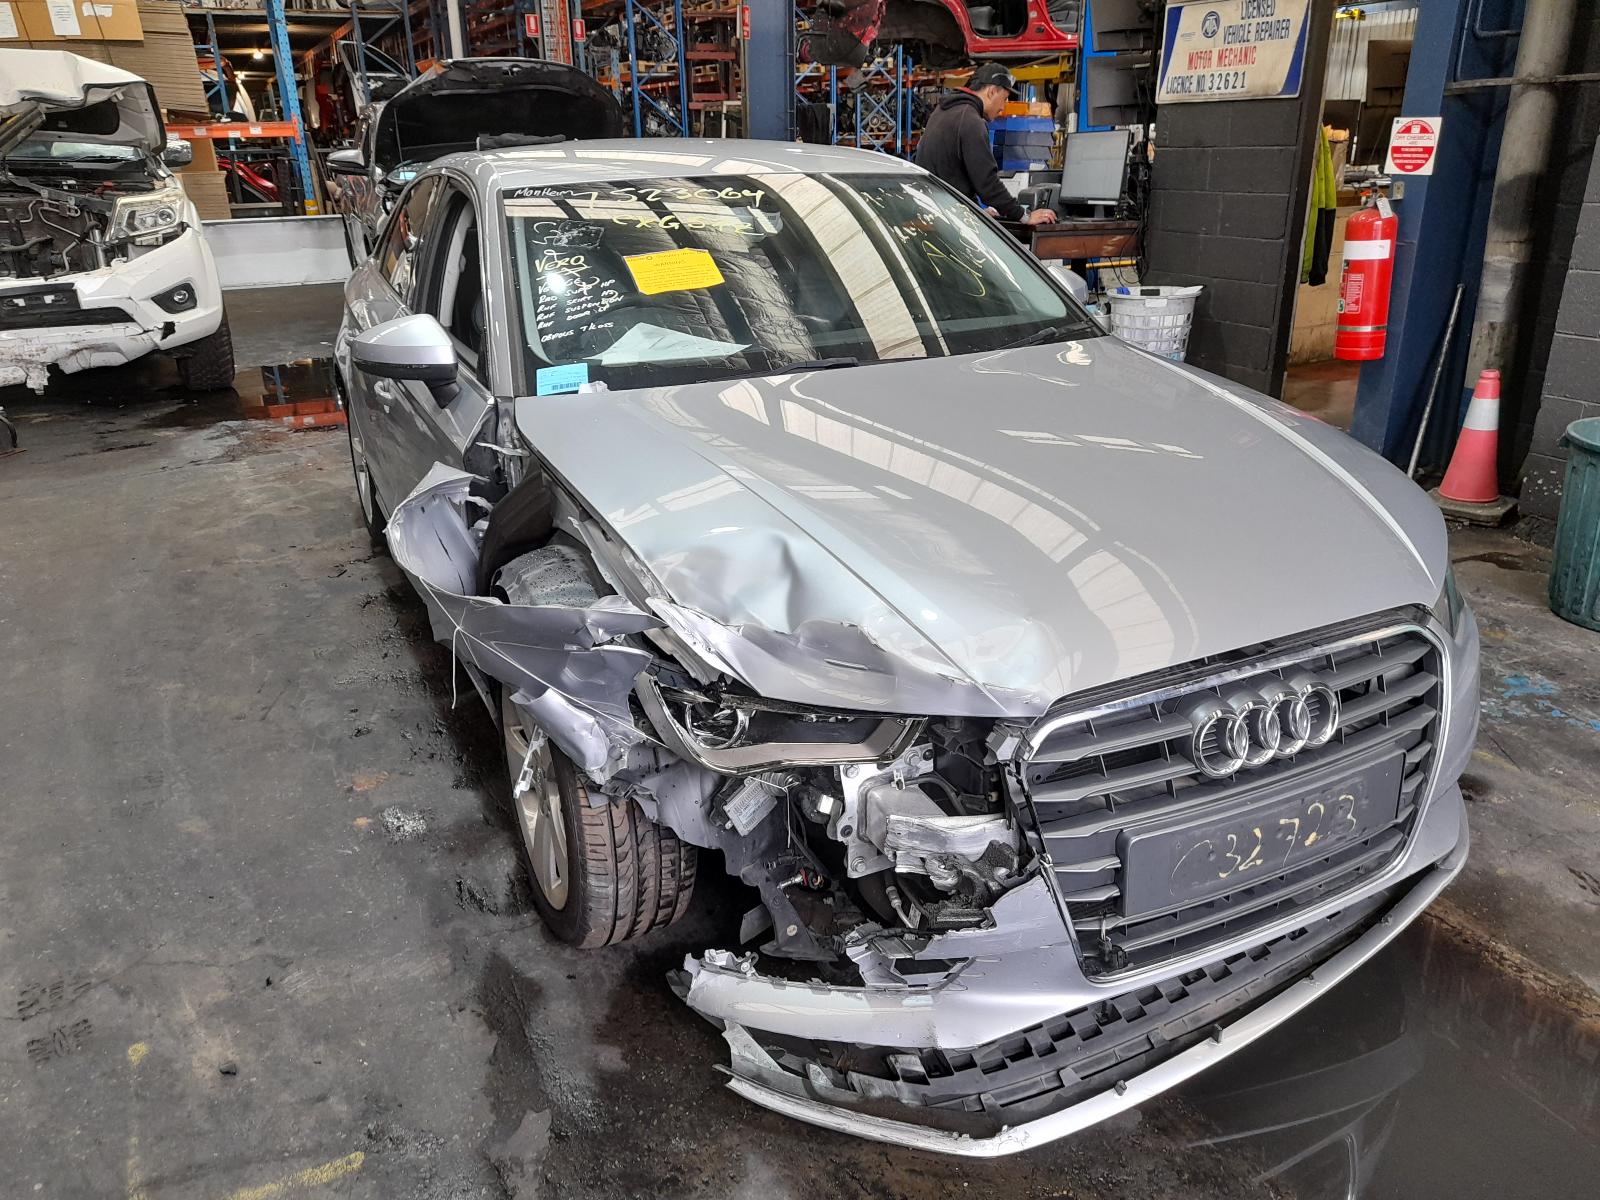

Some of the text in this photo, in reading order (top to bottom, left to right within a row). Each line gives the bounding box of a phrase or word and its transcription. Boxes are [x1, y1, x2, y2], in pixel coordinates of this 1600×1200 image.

[1241, 0, 1276, 20] LICENSED
[1223, 23, 1252, 45] VEHICLE
[1254, 18, 1291, 42] REPAIRER
[1187, 45, 1257, 71] MOTOR MECHANIC
[1165, 75, 1194, 95] LICENCE
[1208, 70, 1247, 91] 32621
